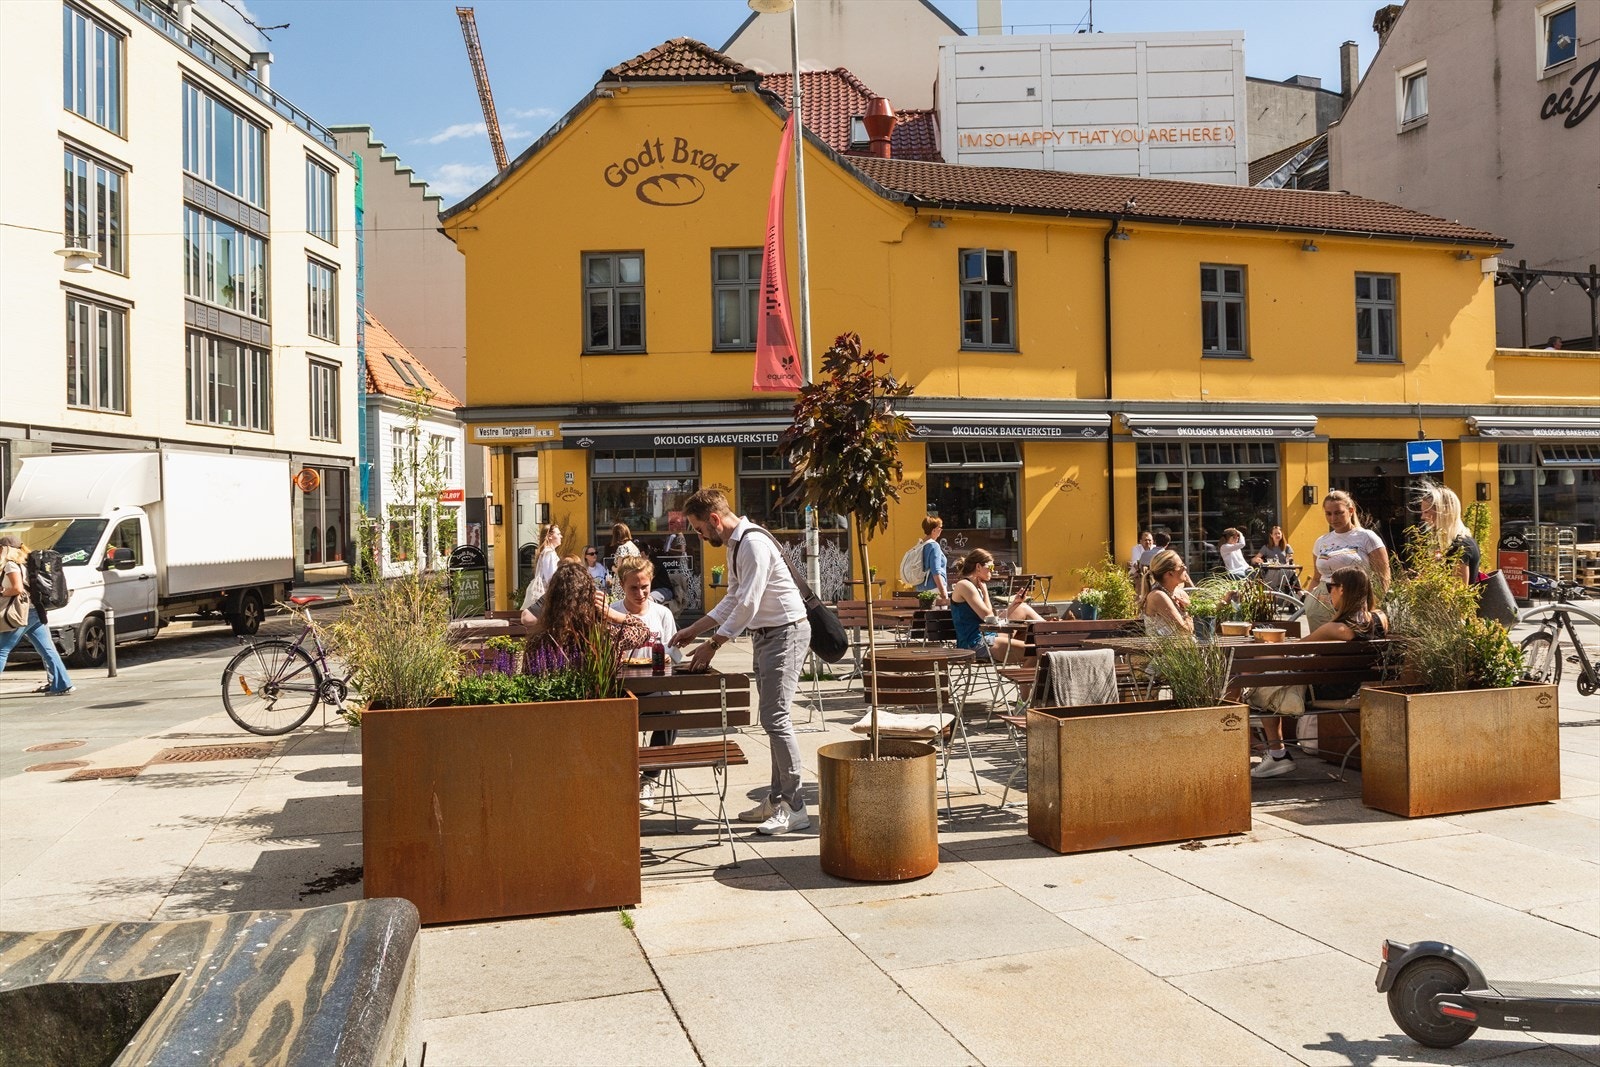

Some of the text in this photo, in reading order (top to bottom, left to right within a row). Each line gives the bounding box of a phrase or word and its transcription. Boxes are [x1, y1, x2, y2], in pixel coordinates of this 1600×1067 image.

[959, 133, 982, 148] I'M
[985, 133, 1005, 148] SO
[1007, 131, 1064, 148] HAPPY
[1068, 130, 1109, 145] THAT
[1112, 128, 1144, 144] YOU
[1148, 128, 1177, 143] ARE
[1180, 127, 1220, 142] HERE
[604, 137, 740, 188] Godt Brød
[766, 373, 795, 382] equinor
[479, 428, 499, 436] Vestre
[501, 427, 532, 437] Torggaten
[952, 426, 1062, 436] ØKOLOGISK BAKEVERKSTED
[1177, 428, 1274, 436] ØKOLOGISK BAKEVERKSTED
[653, 433, 779, 446] ØKOLOGISK BAKEVERKSTED
